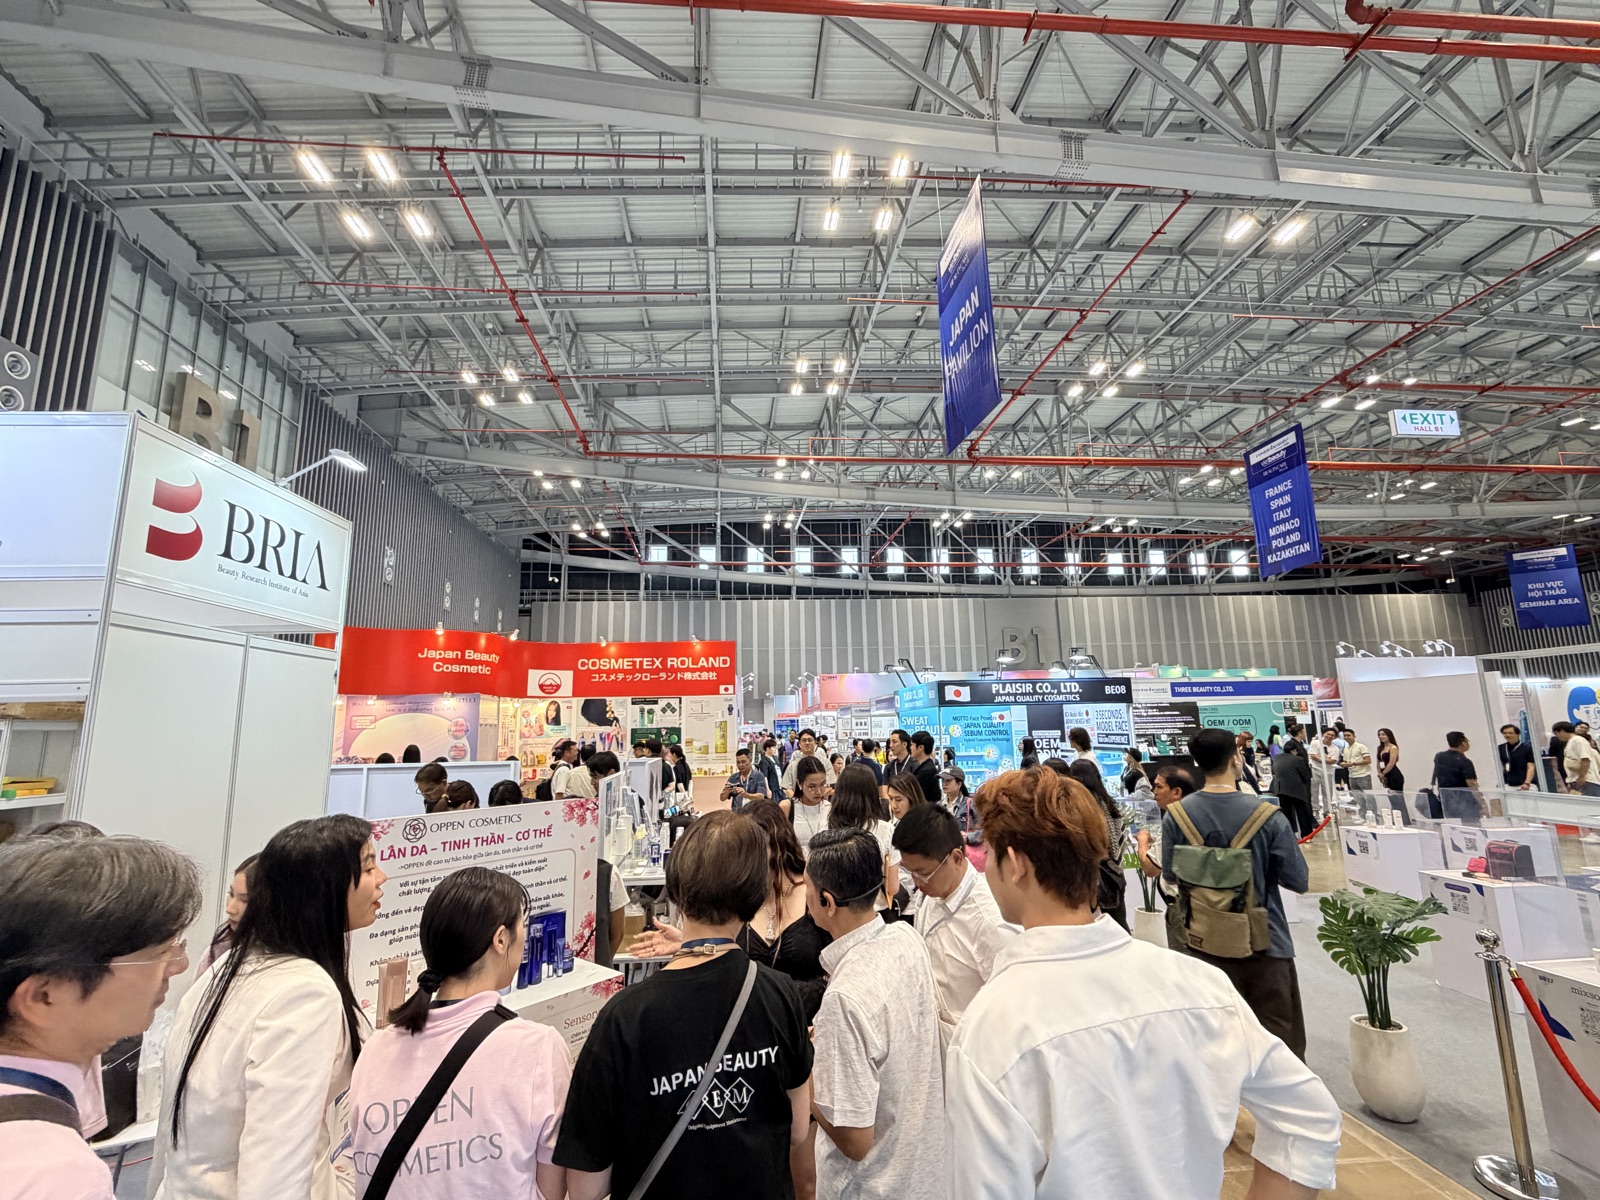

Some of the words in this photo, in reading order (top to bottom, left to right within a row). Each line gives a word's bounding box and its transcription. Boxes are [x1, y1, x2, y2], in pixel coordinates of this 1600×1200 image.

[949, 285, 980, 347] JAPAN
[945, 311, 989, 378] PAVILION
[1409, 413, 1446, 425] EXIT
[1265, 479, 1293, 499] FRANCE
[1270, 494, 1291, 510] SPAIN
[1272, 507, 1291, 522] ITALY
[1269, 518, 1300, 537] MONACO
[217, 499, 330, 592] BRIA
[1271, 531, 1301, 549] POLAND
[1267, 542, 1310, 564] KAZAKHTAN
[217, 564, 239, 580] Beauty
[241, 570, 267, 586] Research
[268, 579, 290, 592] Institute
[298, 588, 309, 597] Asia
[1527, 582, 1544, 590] KHU
[1528, 589, 1542, 598] HỘI
[1544, 588, 1567, 596] THẢO
[1519, 600, 1556, 608] SEMINAR
[1558, 597, 1580, 605] AREA
[1000, 628, 1045, 665] B1
[418, 648, 461, 660] Japan
[465, 649, 500, 664] Beauty
[577, 657, 663, 670] COSMETEX
[667, 656, 730, 669] ROLAND
[432, 661, 492, 674] Cosmetic
[591, 671, 717, 682] コスメテックローランド株式会社
[992, 683, 1033, 694] PLAISIR
[1036, 682, 1057, 694] CO.,
[1060, 682, 1082, 693] LTD.
[1104, 685, 1127, 694] BE08
[1044, 694, 1080, 702] COSMETICS
[901, 716, 928, 726] SWEAT
[1096, 721, 1114, 732] MODEL
[1115, 720, 1129, 732] FACE
[1206, 719, 1225, 727] OEM
[1232, 718, 1252, 726] ODM
[964, 729, 984, 737] SEBUM
[985, 729, 1010, 737] CONTROL
[1034, 738, 1060, 749] OEM
[430, 820, 465, 833] OPPEN
[468, 813, 522, 828] COSMETICS
[410, 844, 428, 857] DA
[440, 838, 471, 852] TINH
[515, 828, 530, 841] CƠ
[379, 928, 396, 938] dạng
[388, 936, 403, 945] giúp
[650, 1062, 708, 1096] JAPAN
[363, 1086, 474, 1135] OPEN
[353, 1132, 503, 1177] COMETICS
